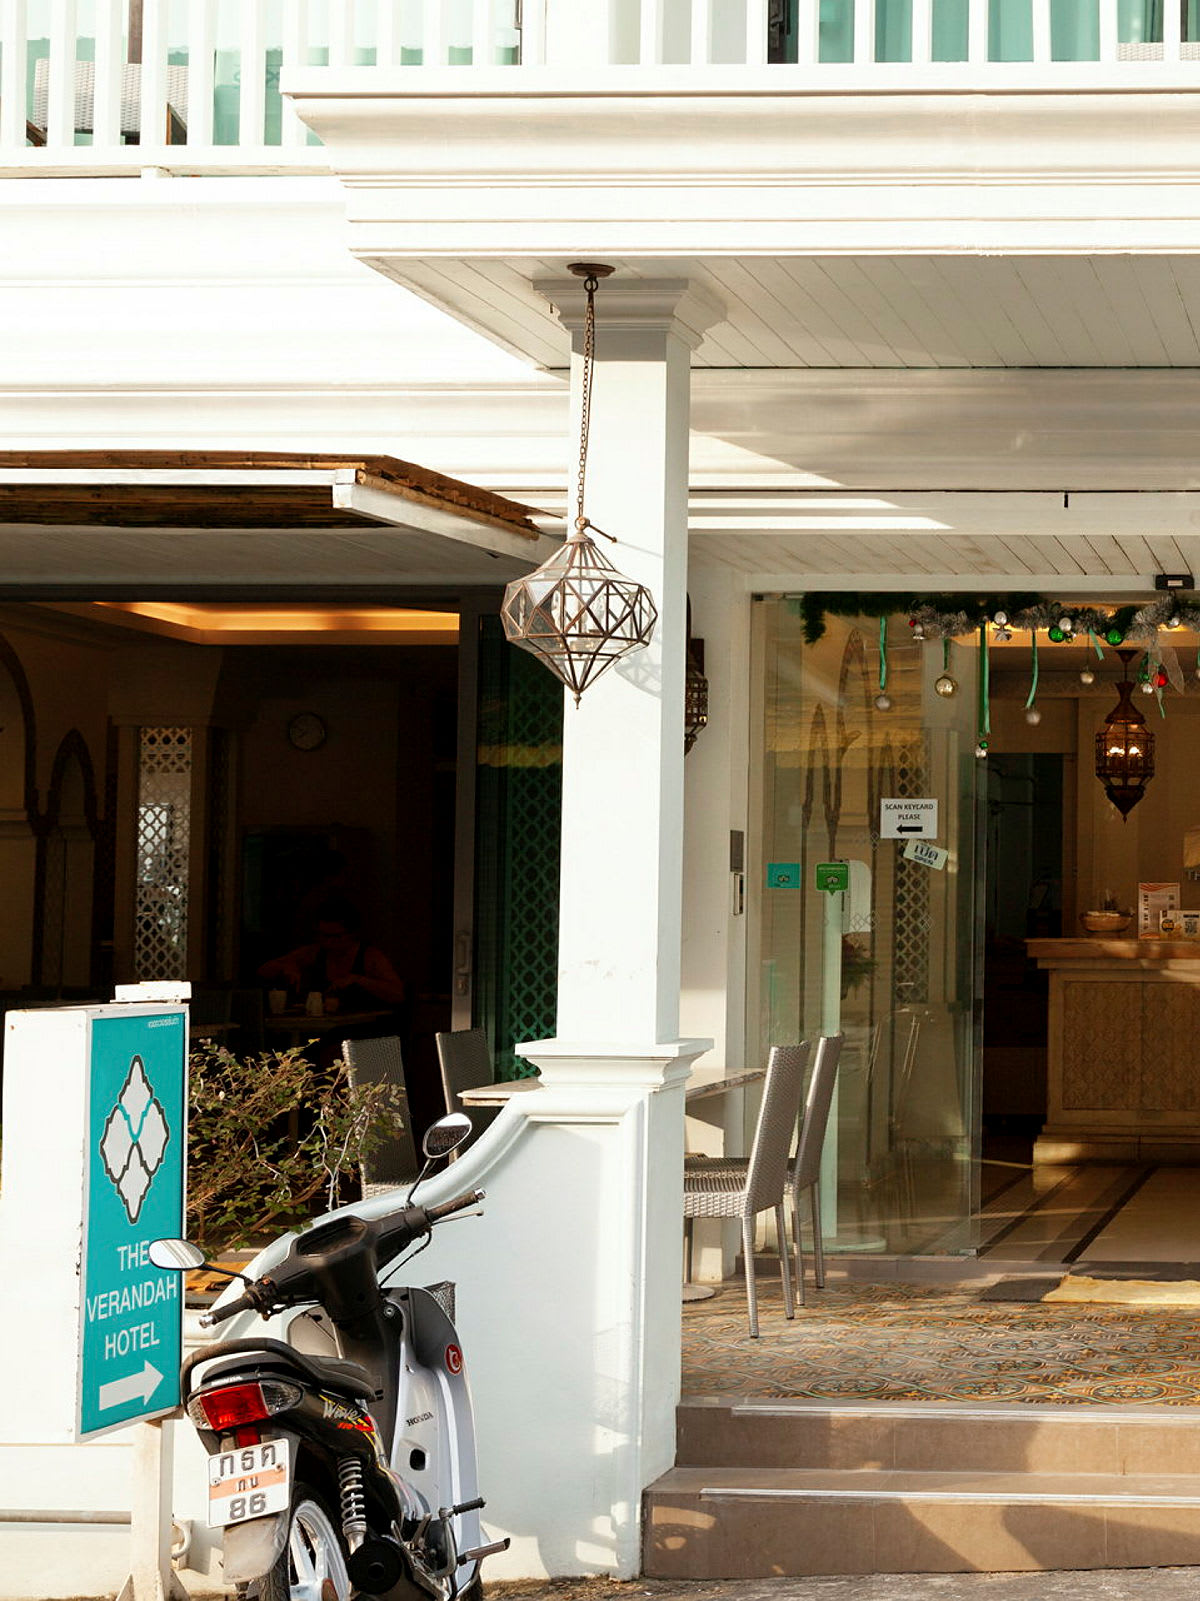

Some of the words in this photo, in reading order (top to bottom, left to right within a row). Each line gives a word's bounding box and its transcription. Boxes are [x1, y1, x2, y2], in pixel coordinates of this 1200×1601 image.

[117, 1240, 151, 1271] THE
[86, 1274, 178, 1323] VERANDAH
[105, 1321, 160, 1361] HOTEL
[407, 1411, 434, 1427] HONDA
[229, 1493, 266, 1520] 86
